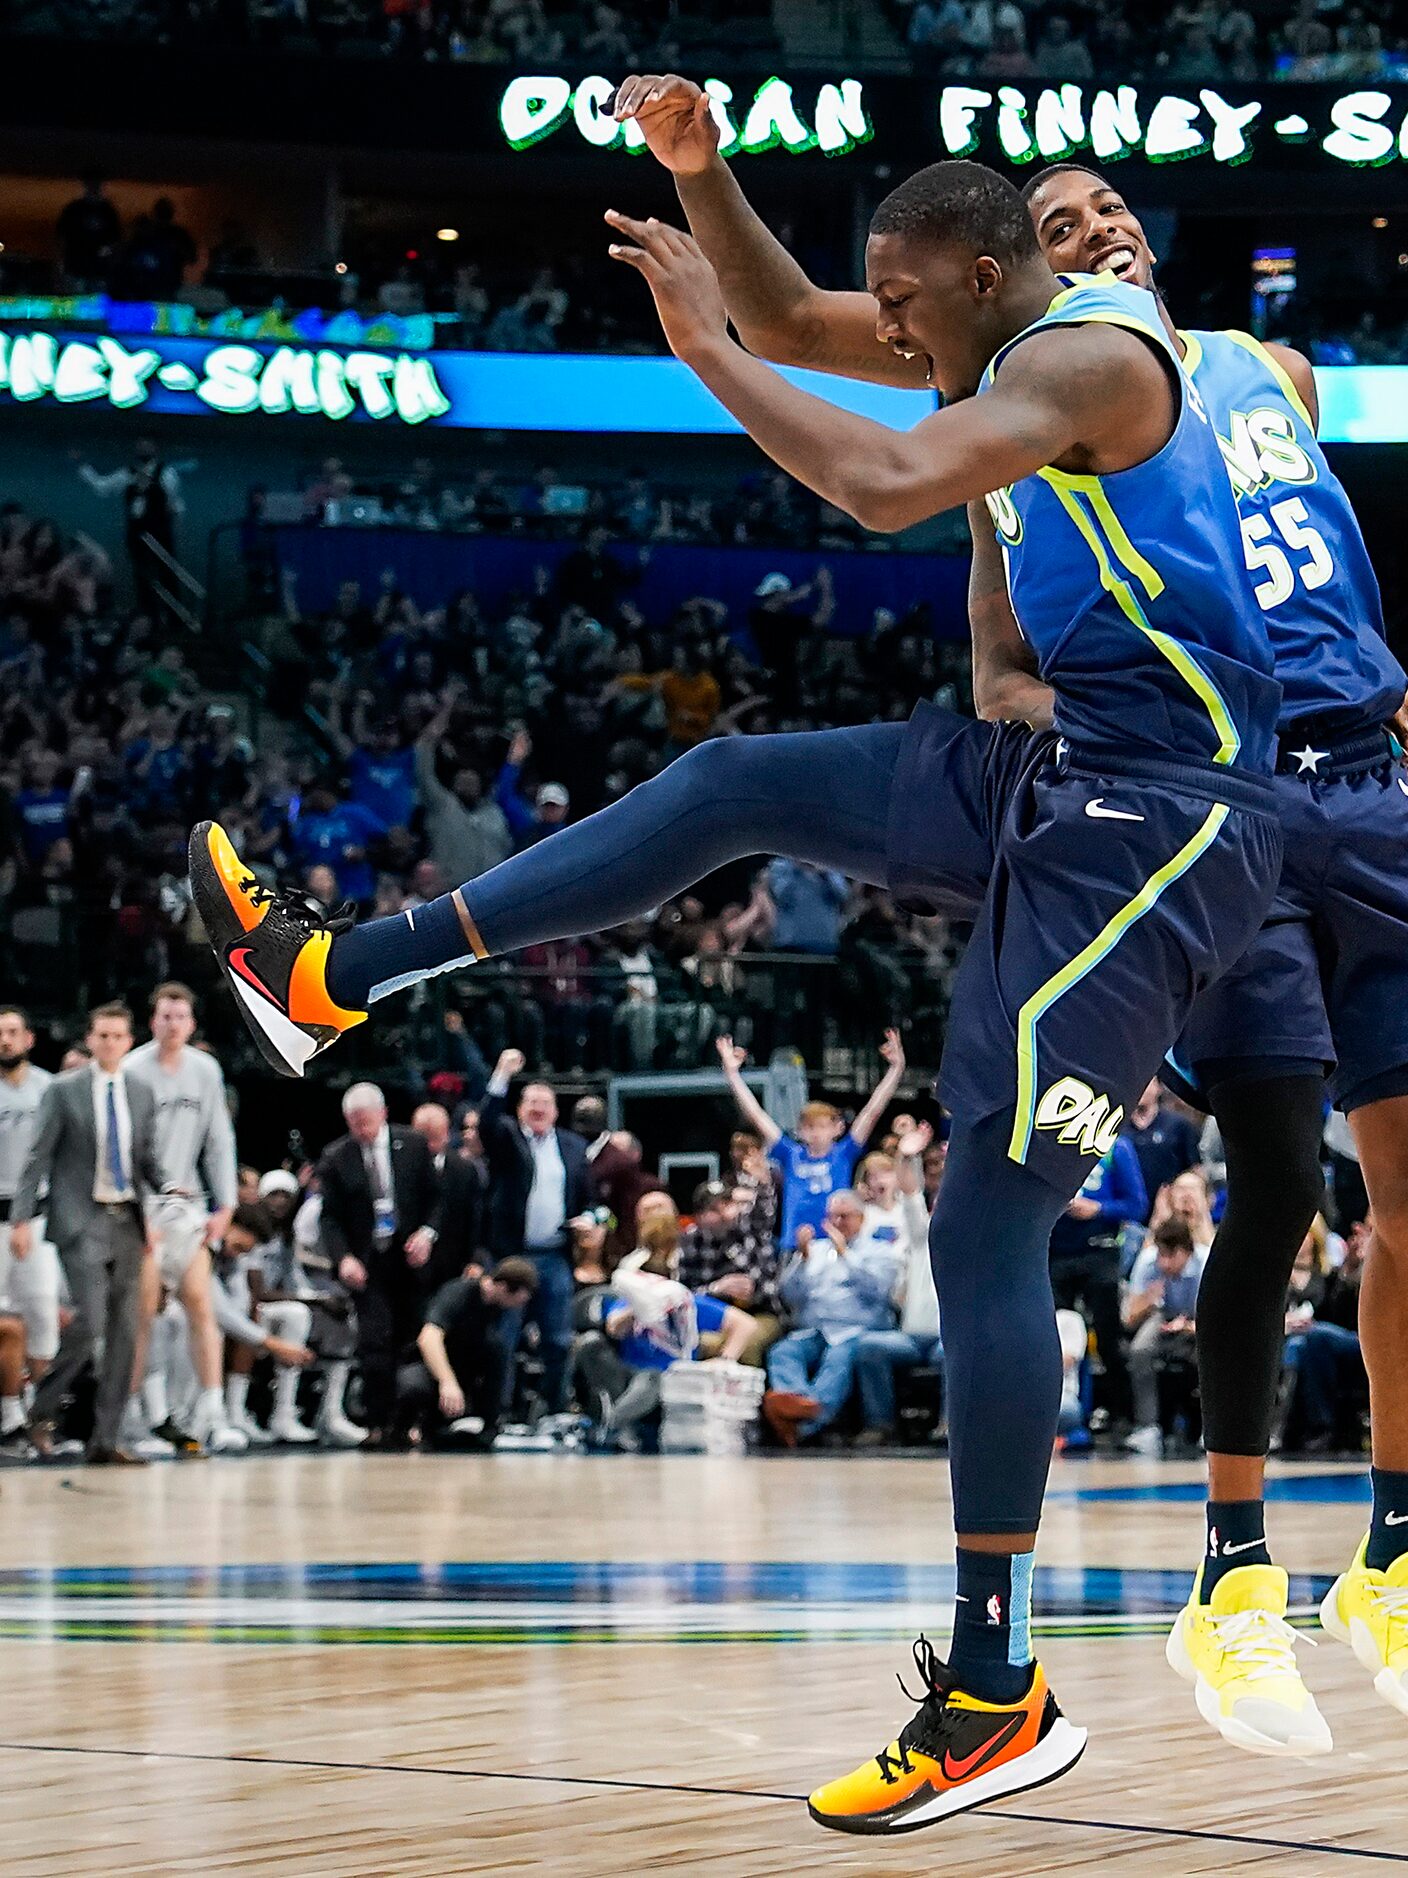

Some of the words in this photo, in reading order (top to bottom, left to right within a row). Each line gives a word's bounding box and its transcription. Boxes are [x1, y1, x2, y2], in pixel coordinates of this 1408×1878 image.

[501, 75, 871, 157] DOIAN
[0, 332, 450, 425] NEY-SMITH
[1241, 497, 1334, 611] 55
